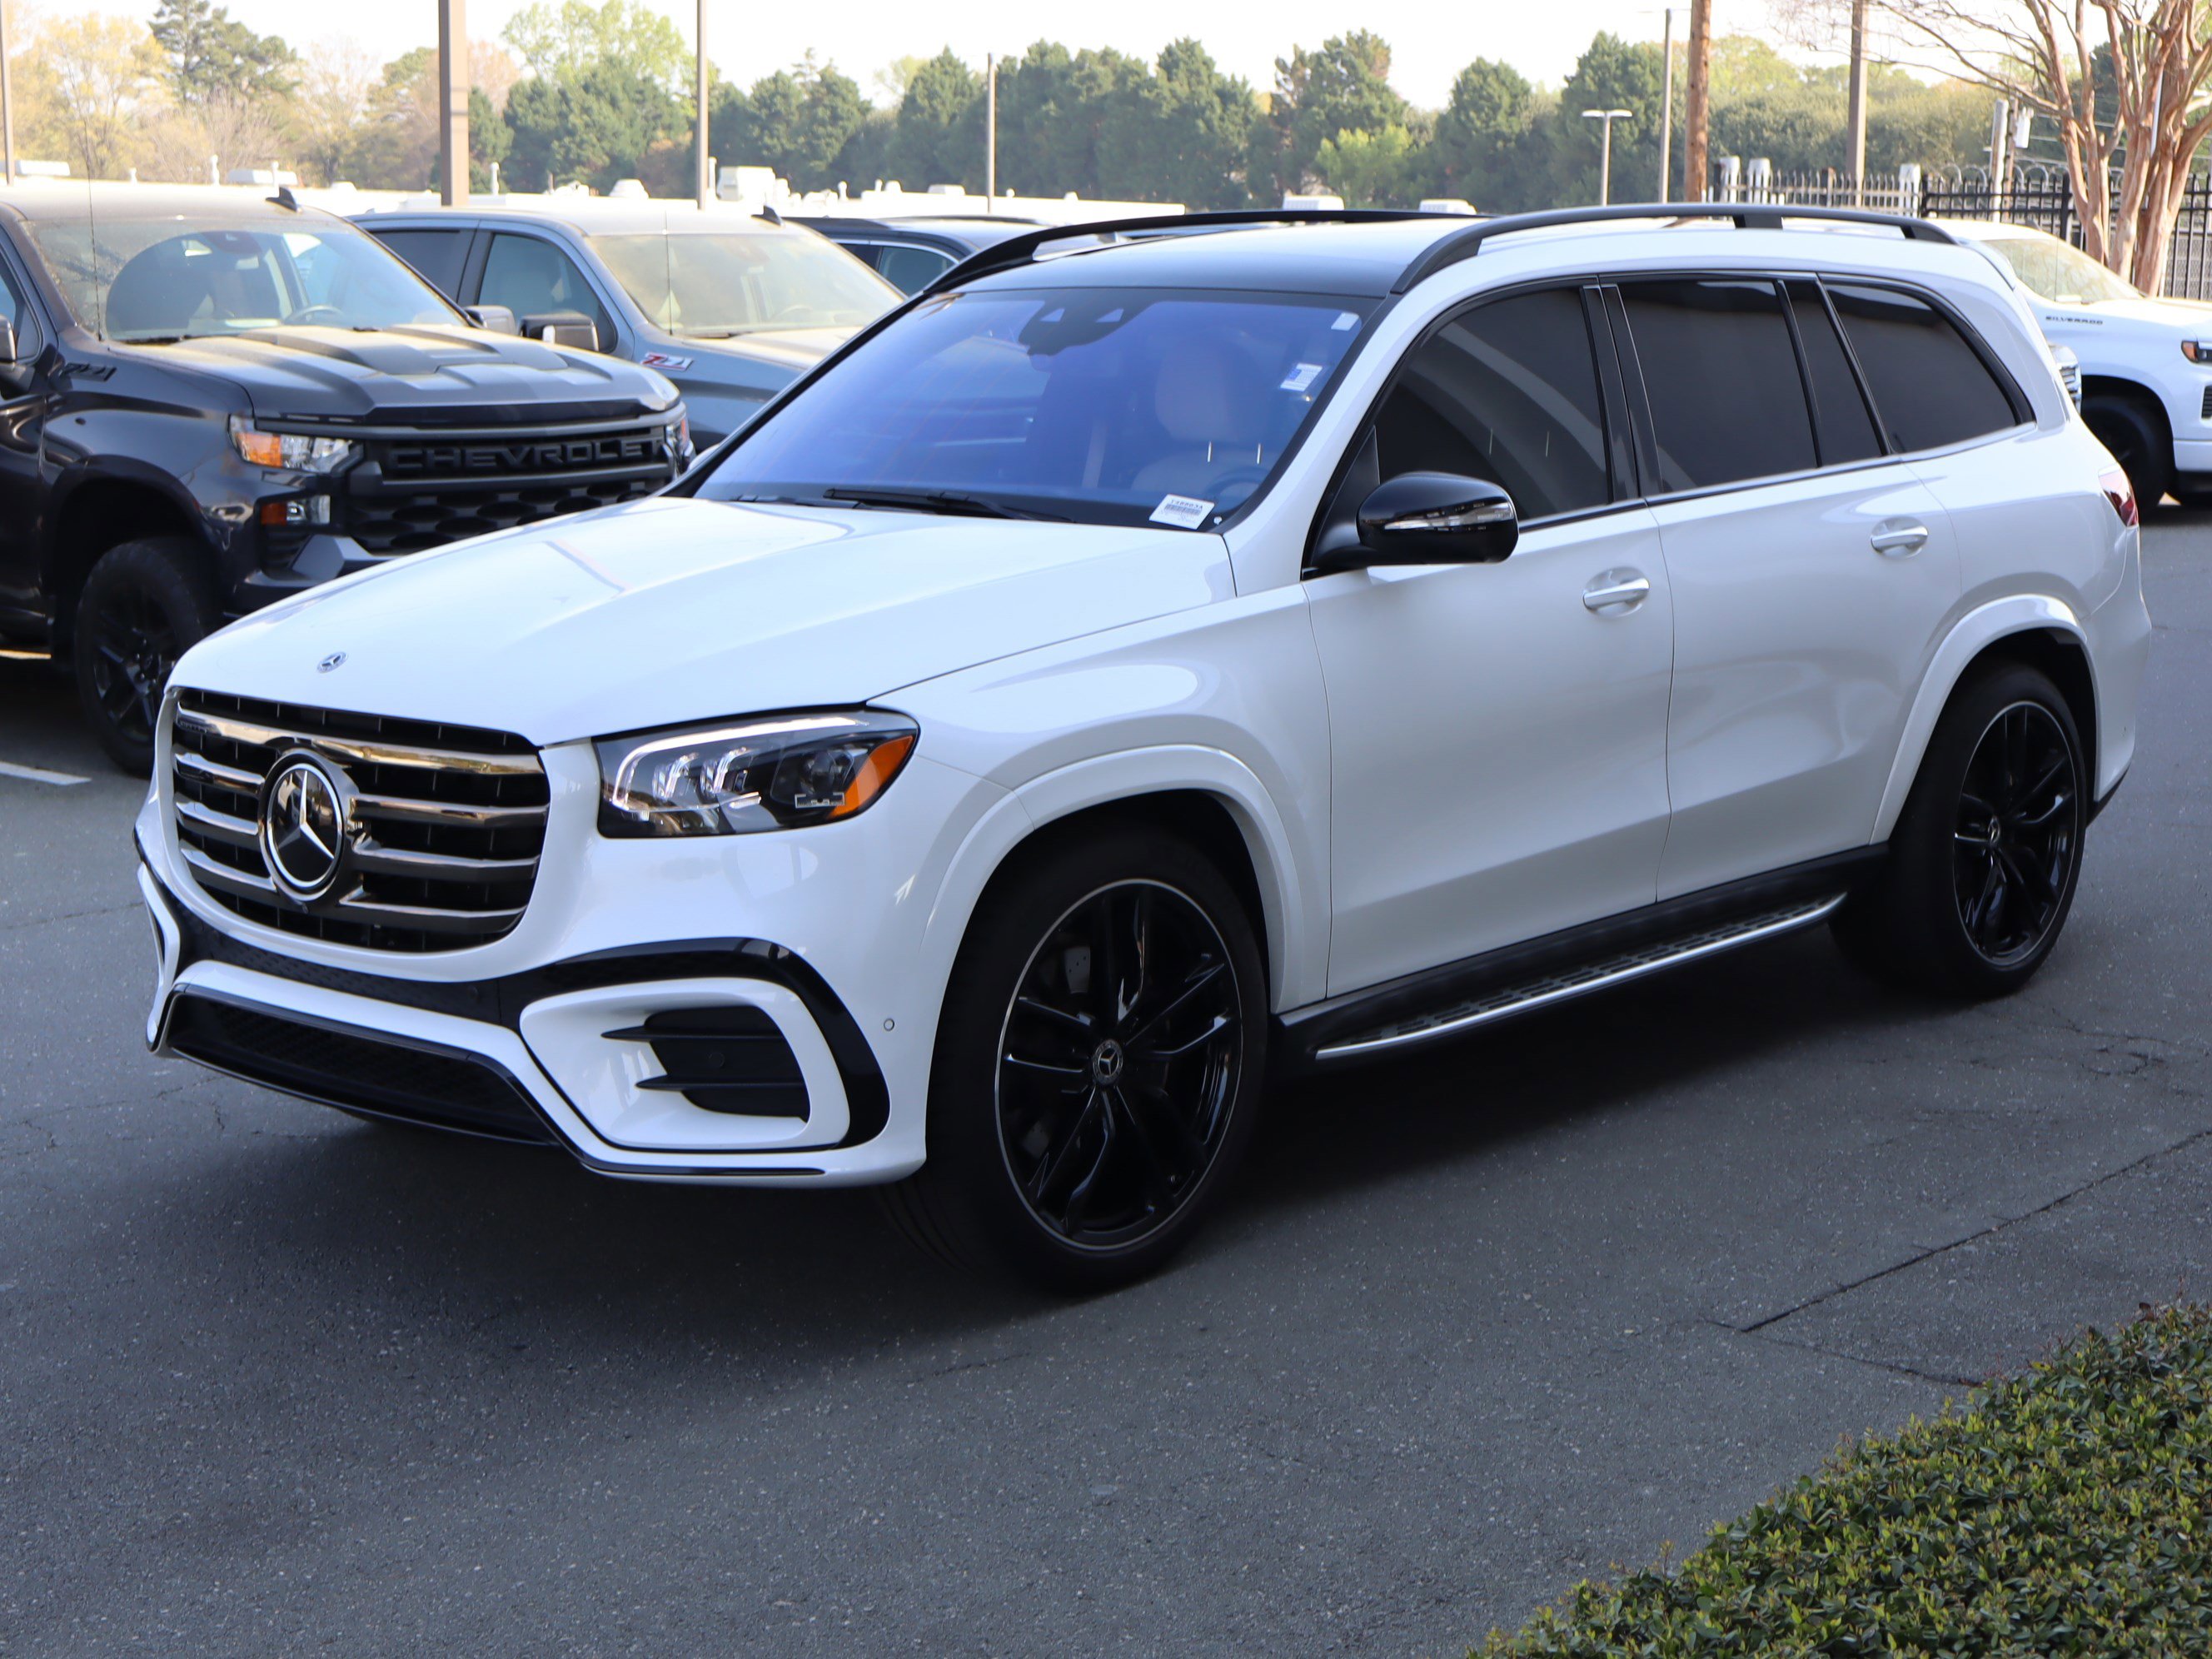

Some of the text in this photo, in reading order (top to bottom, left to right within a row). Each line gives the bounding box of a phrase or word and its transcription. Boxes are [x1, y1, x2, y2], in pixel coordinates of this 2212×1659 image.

[2045, 316, 2103, 325] SILVERADO
[640, 352, 694, 371] Z71
[389, 435, 665, 469] CHEVROLET
